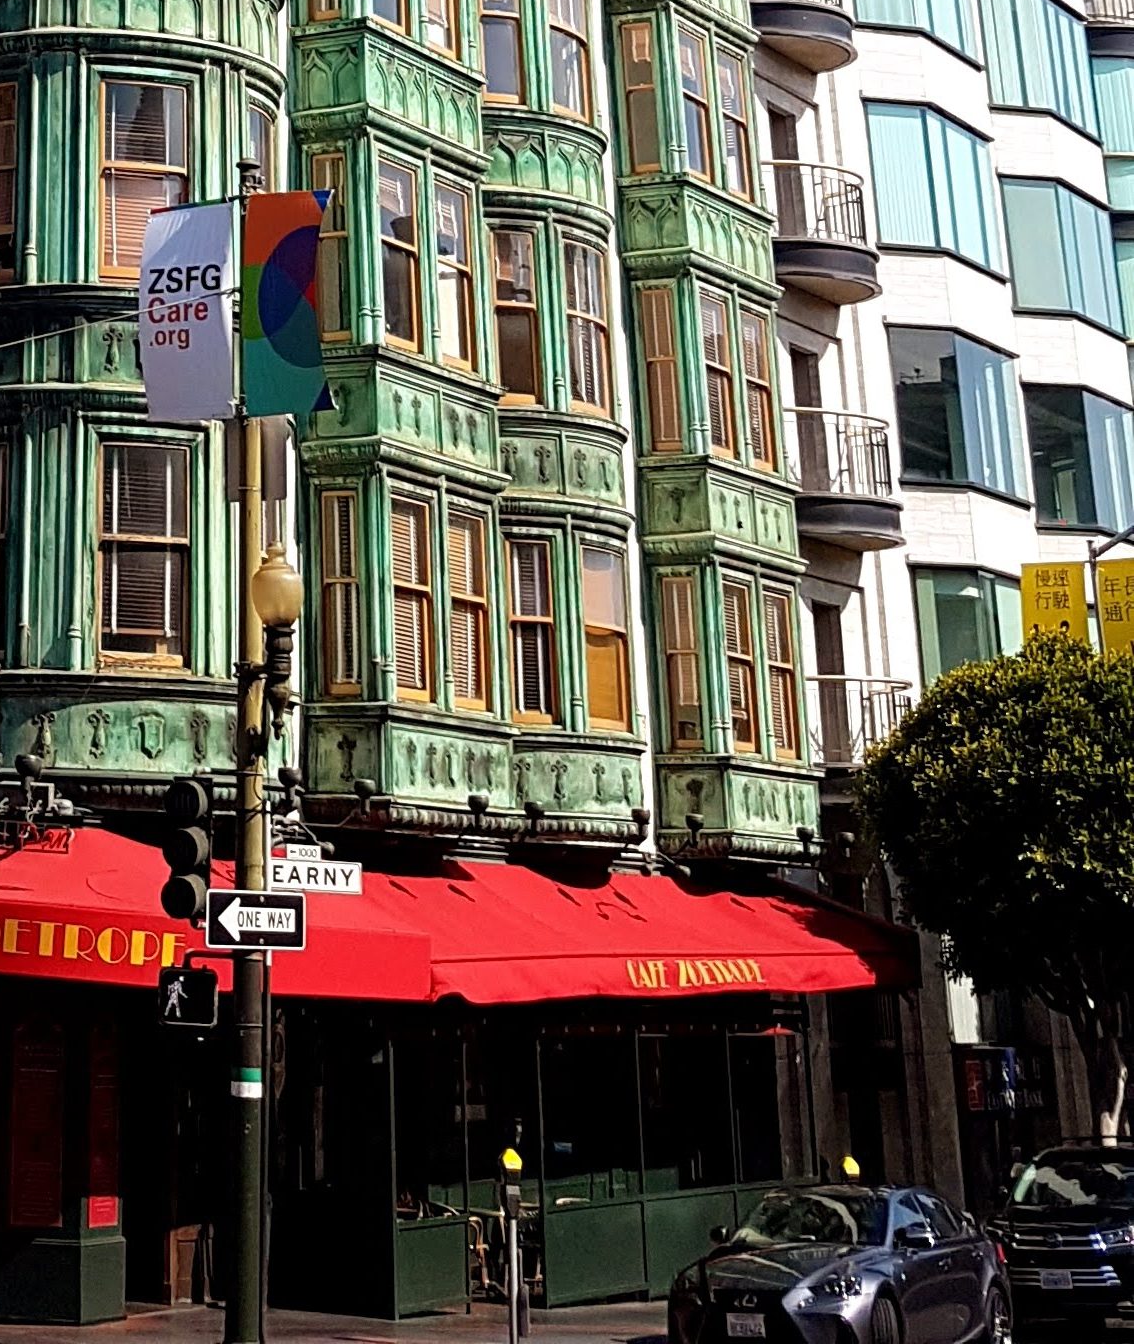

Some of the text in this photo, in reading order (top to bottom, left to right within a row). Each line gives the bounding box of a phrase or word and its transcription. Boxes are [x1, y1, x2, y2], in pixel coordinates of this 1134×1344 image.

[148, 264, 221, 294] ZSFG
[148, 297, 208, 324] Care
[149, 328, 190, 349] .org
[298, 848, 318, 858] 1000
[272, 864, 354, 888] EARNY
[237, 911, 292, 929] ONE WAY
[626, 959, 767, 989] CAFE ZOETROPE
